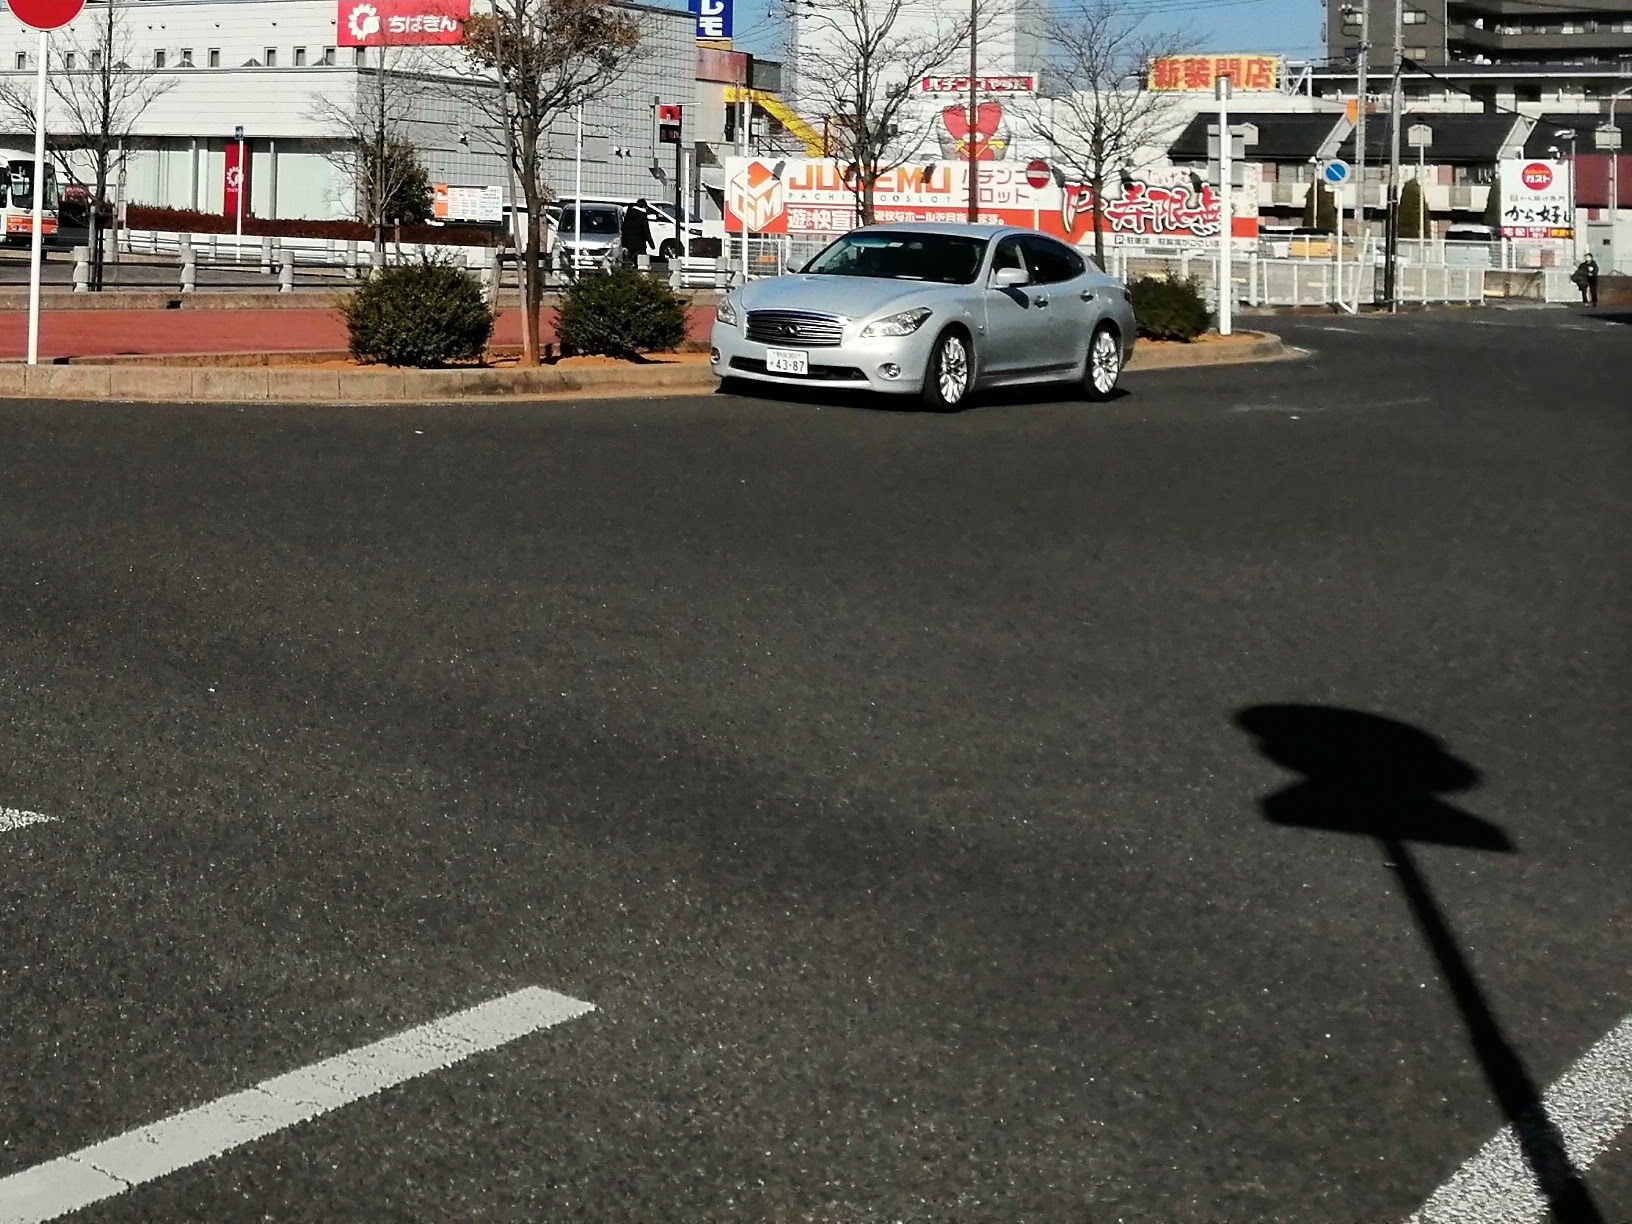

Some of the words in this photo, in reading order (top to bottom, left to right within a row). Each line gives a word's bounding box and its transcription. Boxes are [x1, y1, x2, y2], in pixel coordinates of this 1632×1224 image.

[1525, 174, 1551, 184] ガスト
[776, 359, 805, 372] 43-87
